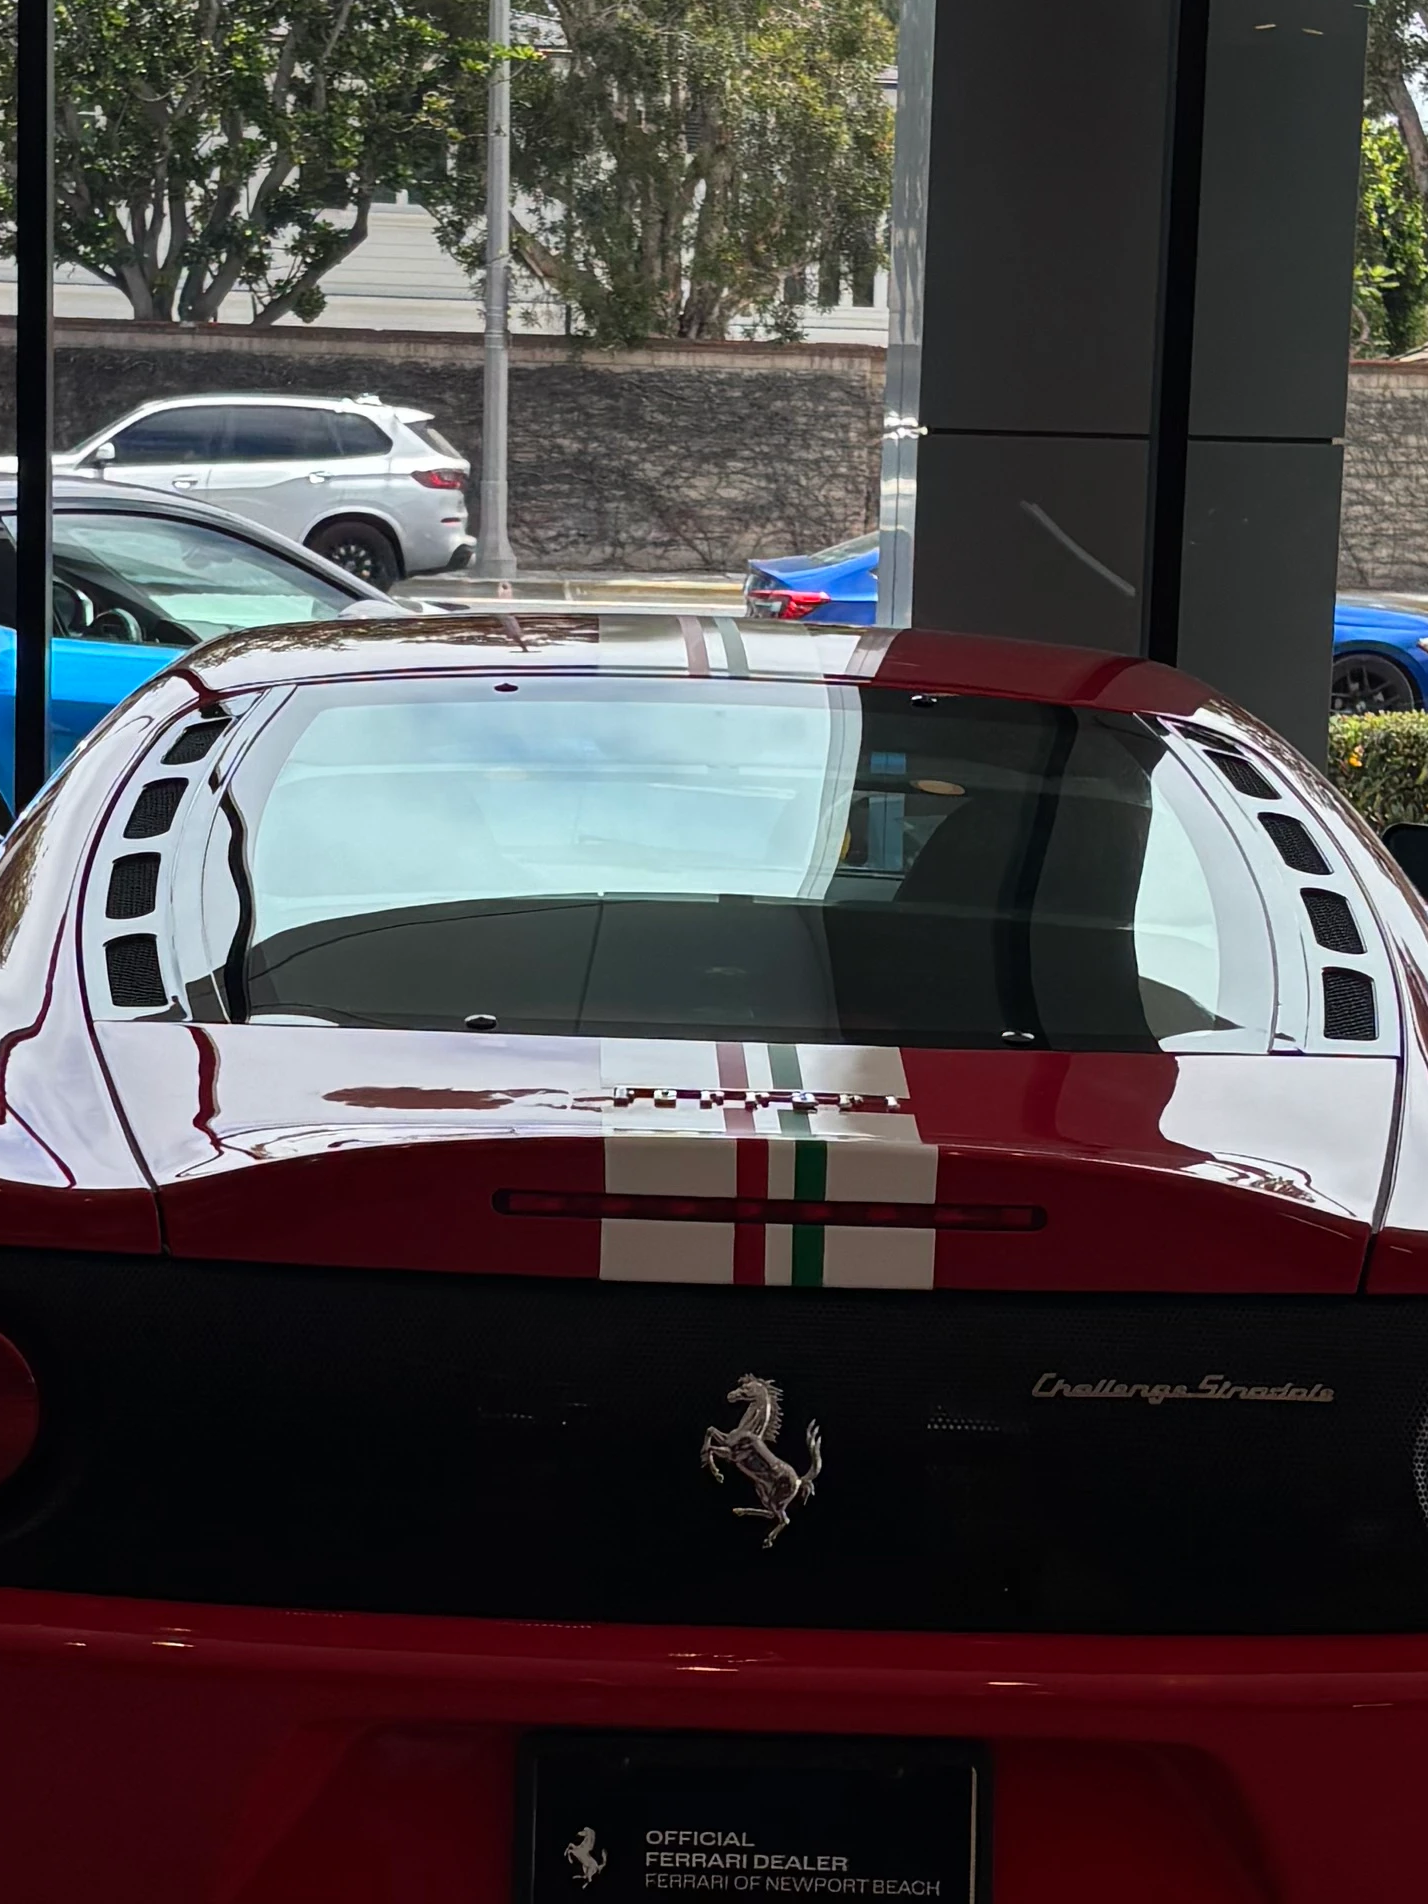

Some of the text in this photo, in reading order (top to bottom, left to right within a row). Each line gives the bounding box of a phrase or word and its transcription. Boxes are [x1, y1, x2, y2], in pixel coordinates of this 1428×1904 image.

[1032, 1373, 1335, 1404] Challenge Stradale
[646, 1831, 756, 1847] OFFICIAL
[646, 1852, 849, 1871] FERRARI DEALER
[646, 1873, 941, 1896] FERRARI OF NEWPORT BEACH
